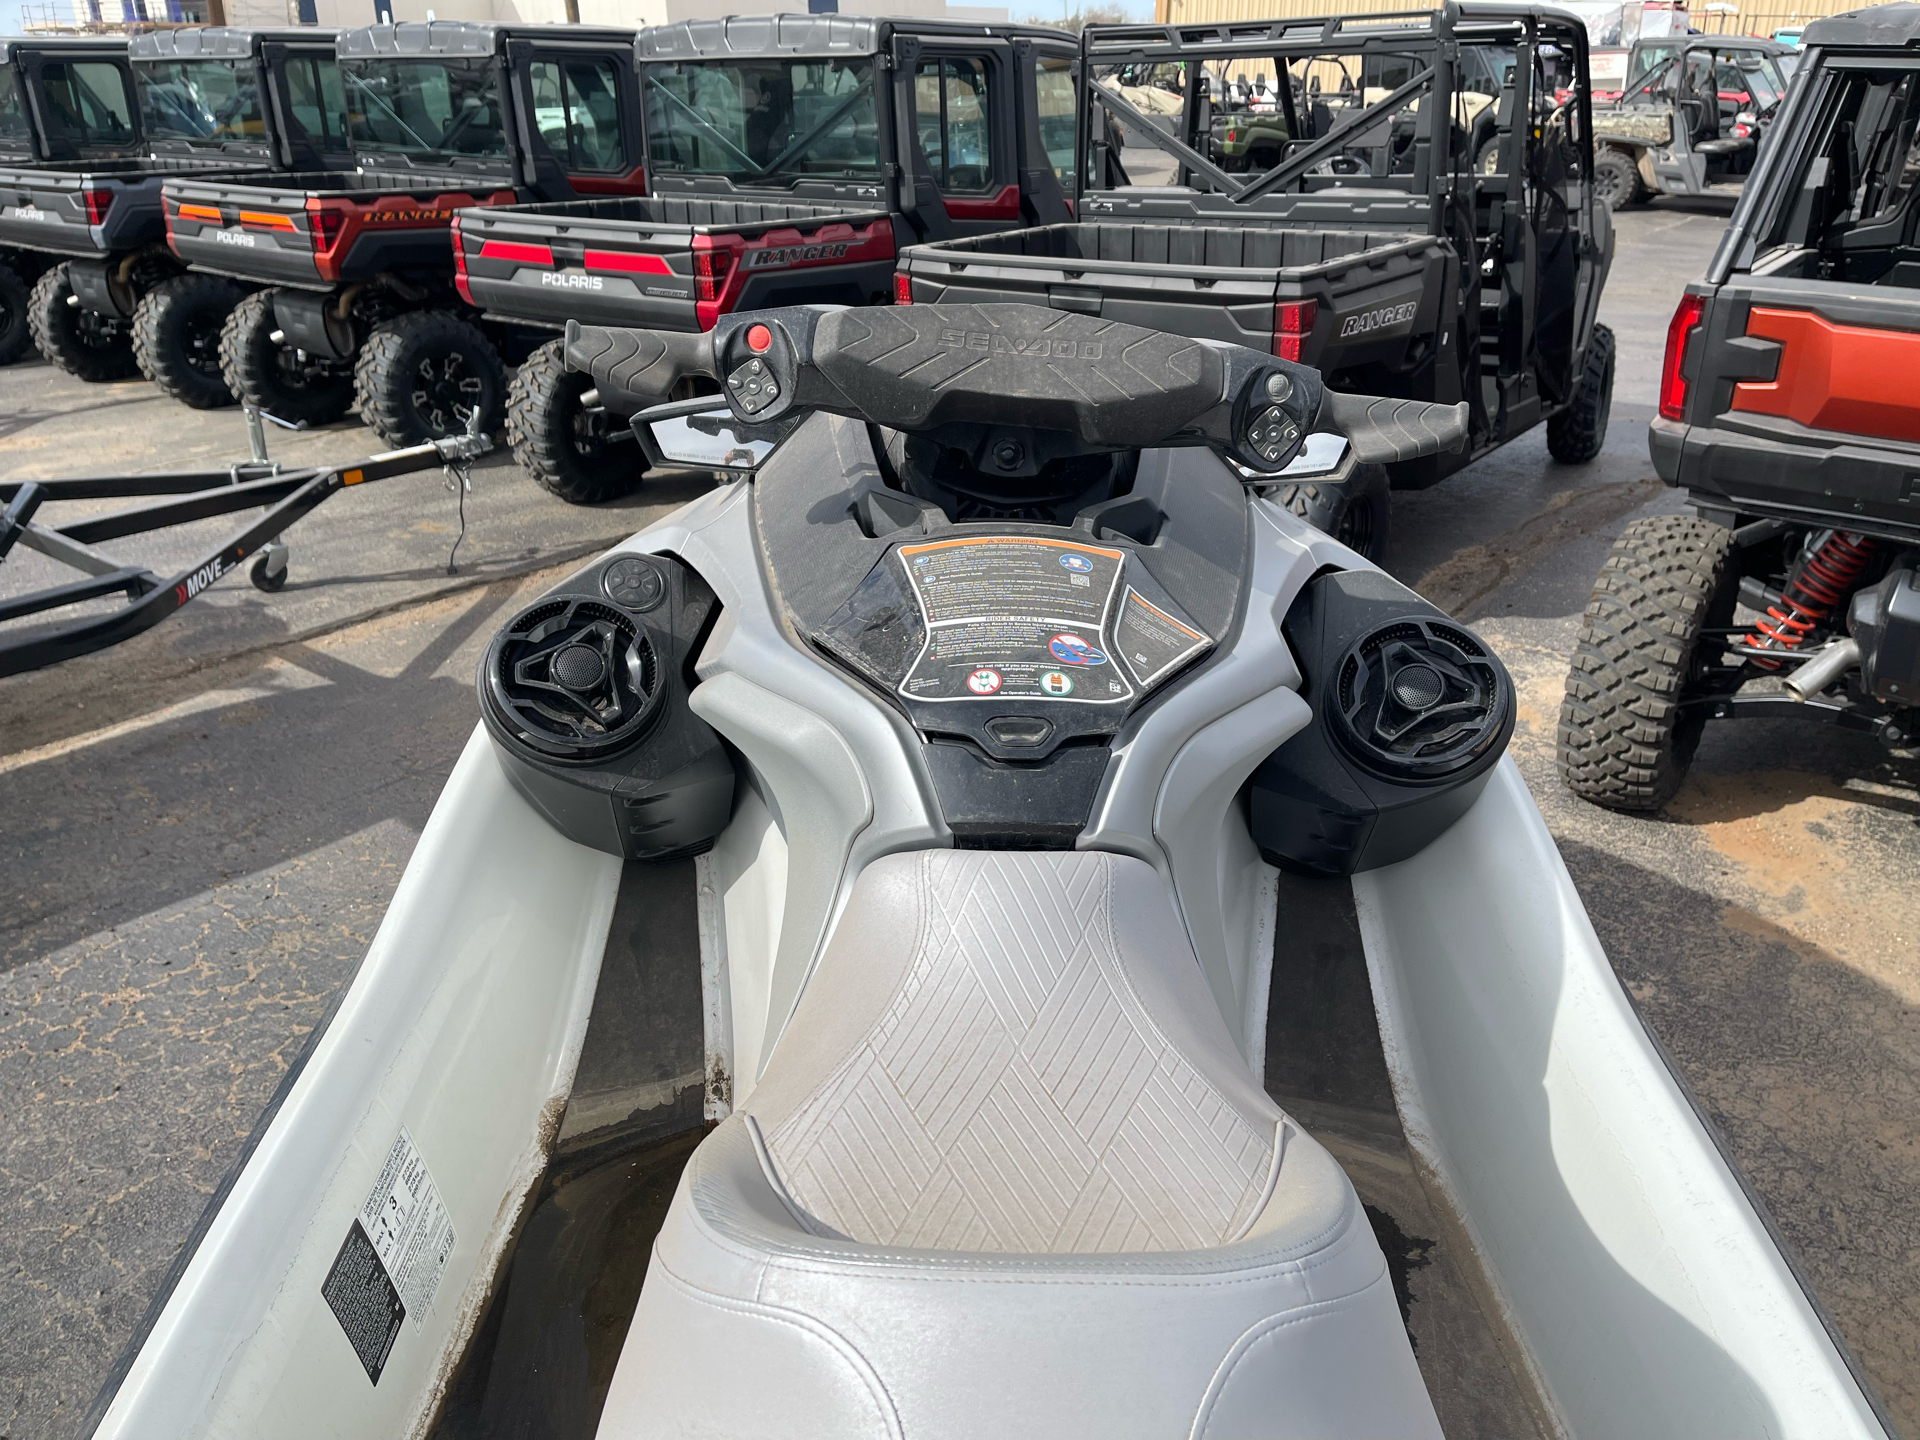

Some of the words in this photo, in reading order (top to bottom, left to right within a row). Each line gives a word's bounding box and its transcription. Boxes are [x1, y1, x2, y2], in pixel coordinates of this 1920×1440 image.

[15, 207, 45, 221] POLARIS
[368, 209, 454, 221] RANGE
[216, 230, 255, 247] POLARIS
[754, 244, 848, 265] RANGER
[542, 272, 603, 290] POLARIS
[1340, 301, 1417, 337] RANGER
[186, 556, 222, 598] MOVE
[389, 1196, 397, 1210] 3
